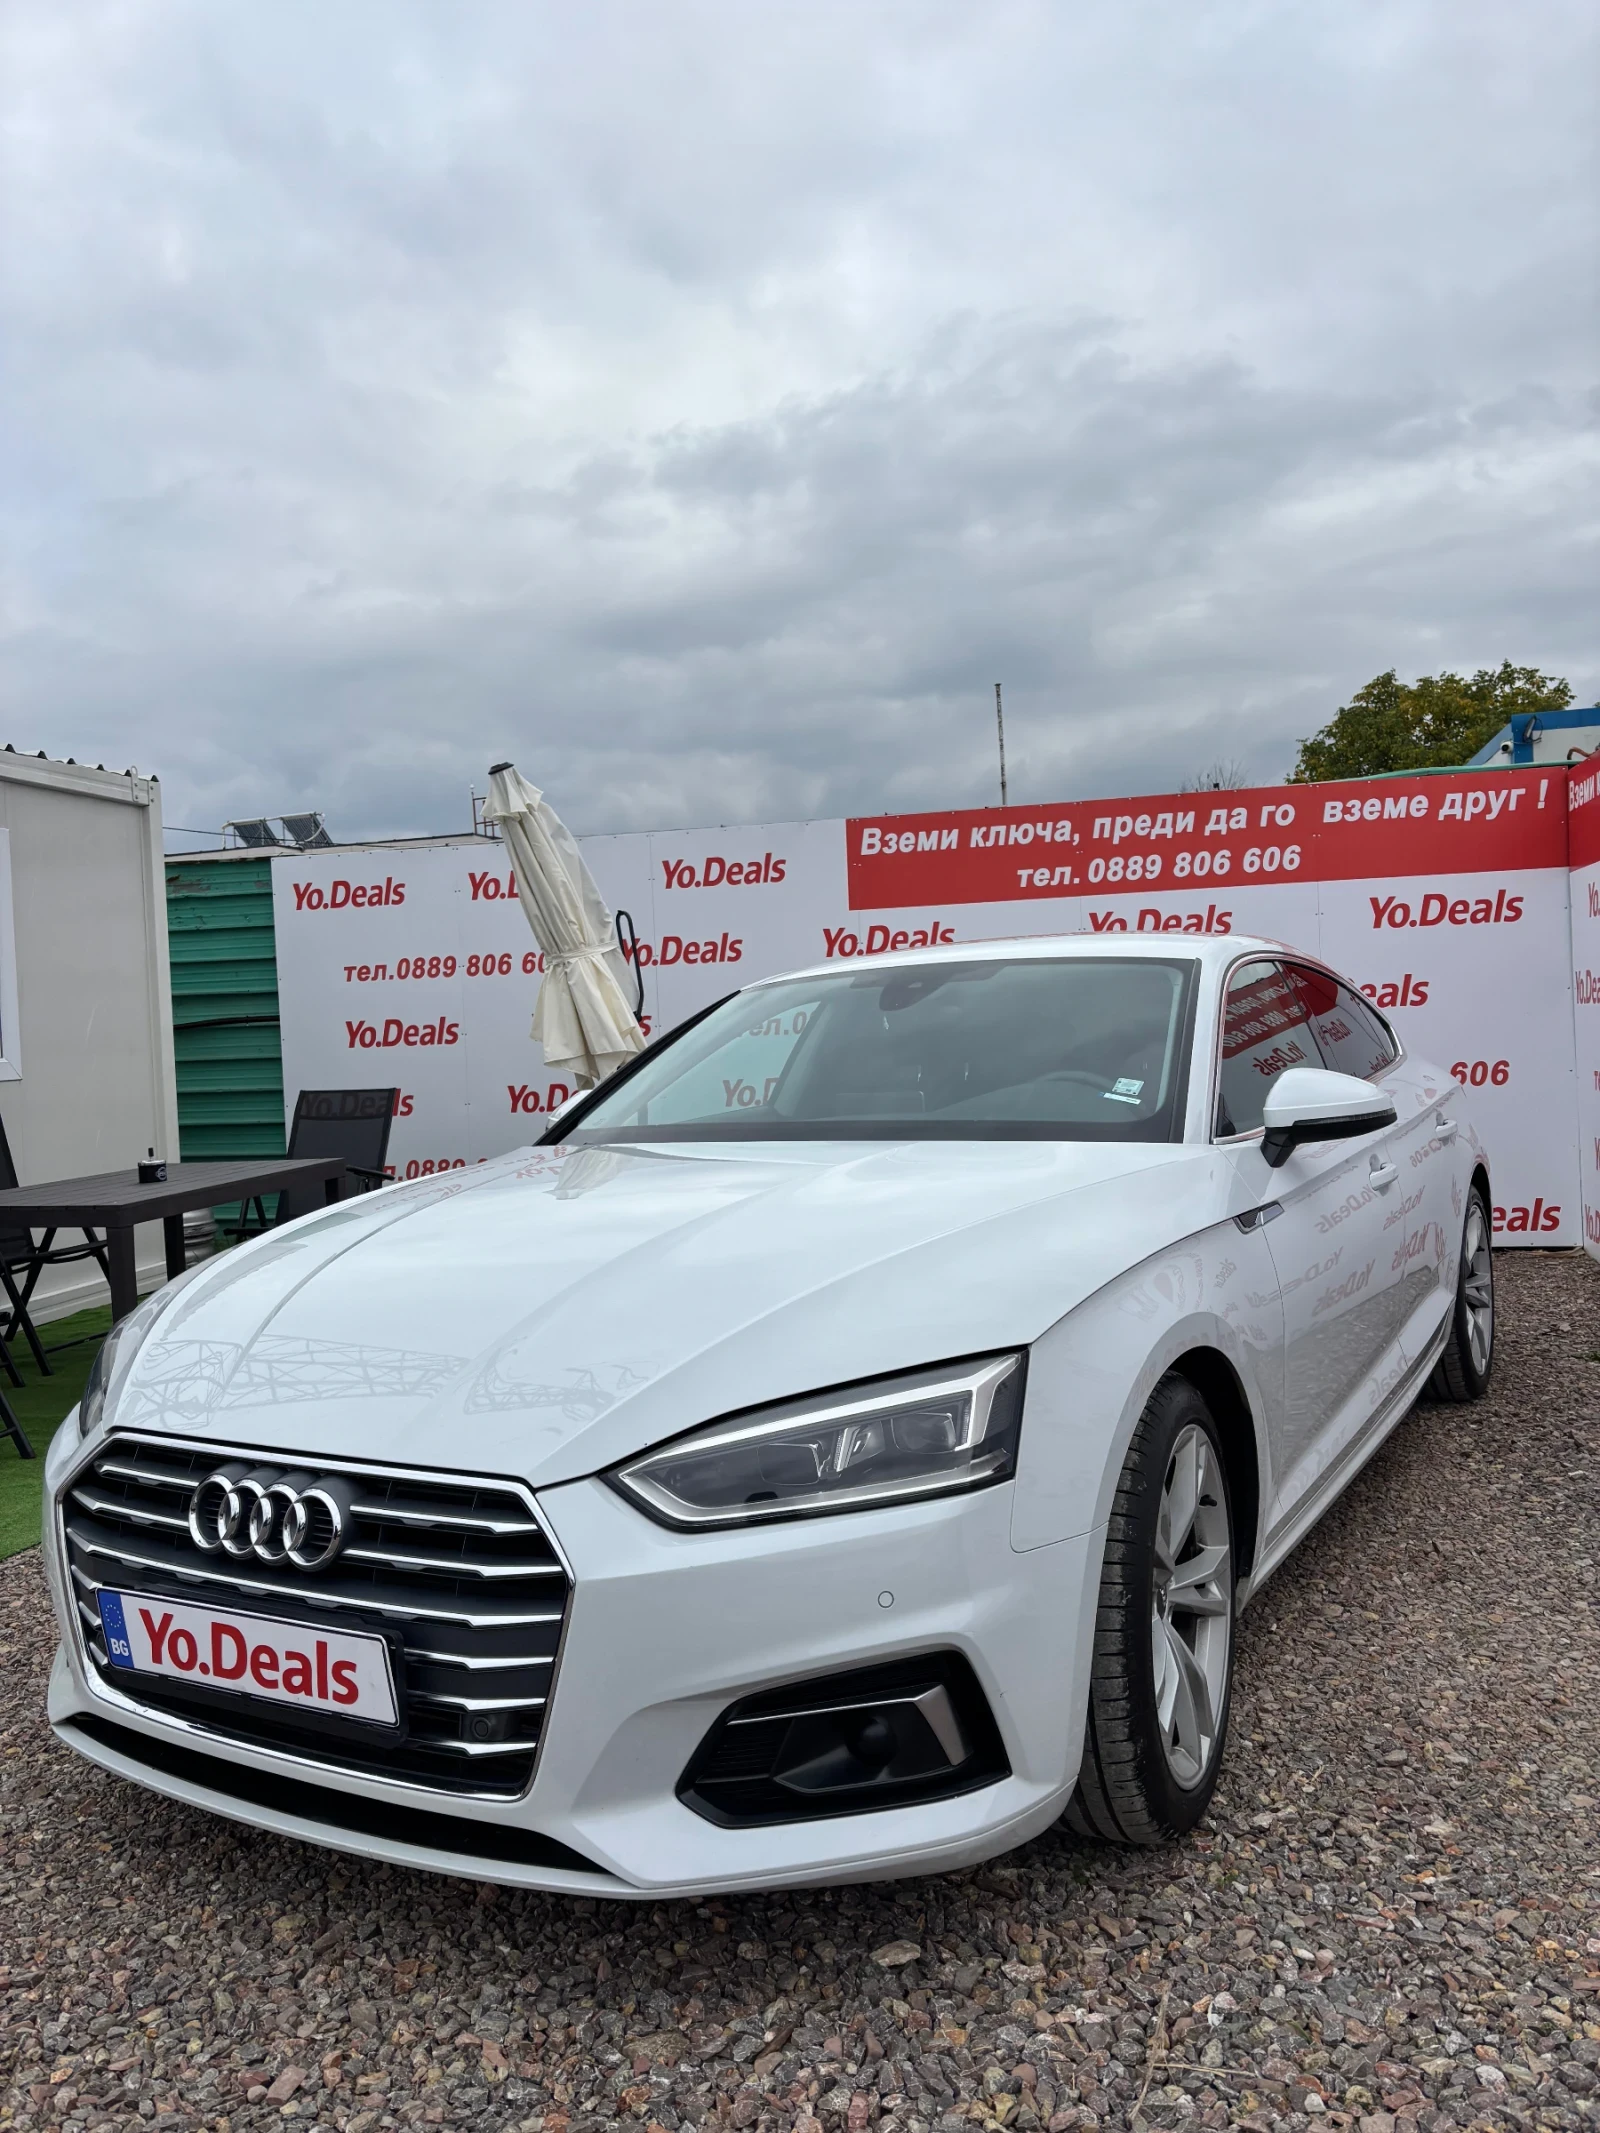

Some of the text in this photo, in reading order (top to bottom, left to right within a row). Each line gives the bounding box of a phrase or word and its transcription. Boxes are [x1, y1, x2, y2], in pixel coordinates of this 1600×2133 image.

[1569, 774, 1595, 812] Вземи
[861, 827, 959, 856] Вземи
[970, 819, 1080, 848] ключа,
[1092, 810, 1196, 845] преди
[1204, 807, 1248, 836] да
[1260, 803, 1296, 828] го
[1323, 794, 1429, 823] вземе
[1438, 788, 1526, 822] друг
[662, 853, 786, 889] Yo.Deals
[1017, 844, 1302, 888] тел. 0889 806 606
[293, 877, 406, 911] Yo.Deals
[1369, 889, 1523, 929] Yo.Deals
[823, 921, 956, 958] Yo.Deals
[466, 953, 512, 977] 806
[345, 1016, 460, 1048] Yo.Deals
[110, 1638, 130, 1658] BG
[138, 1608, 359, 1705] Yo.Deals
